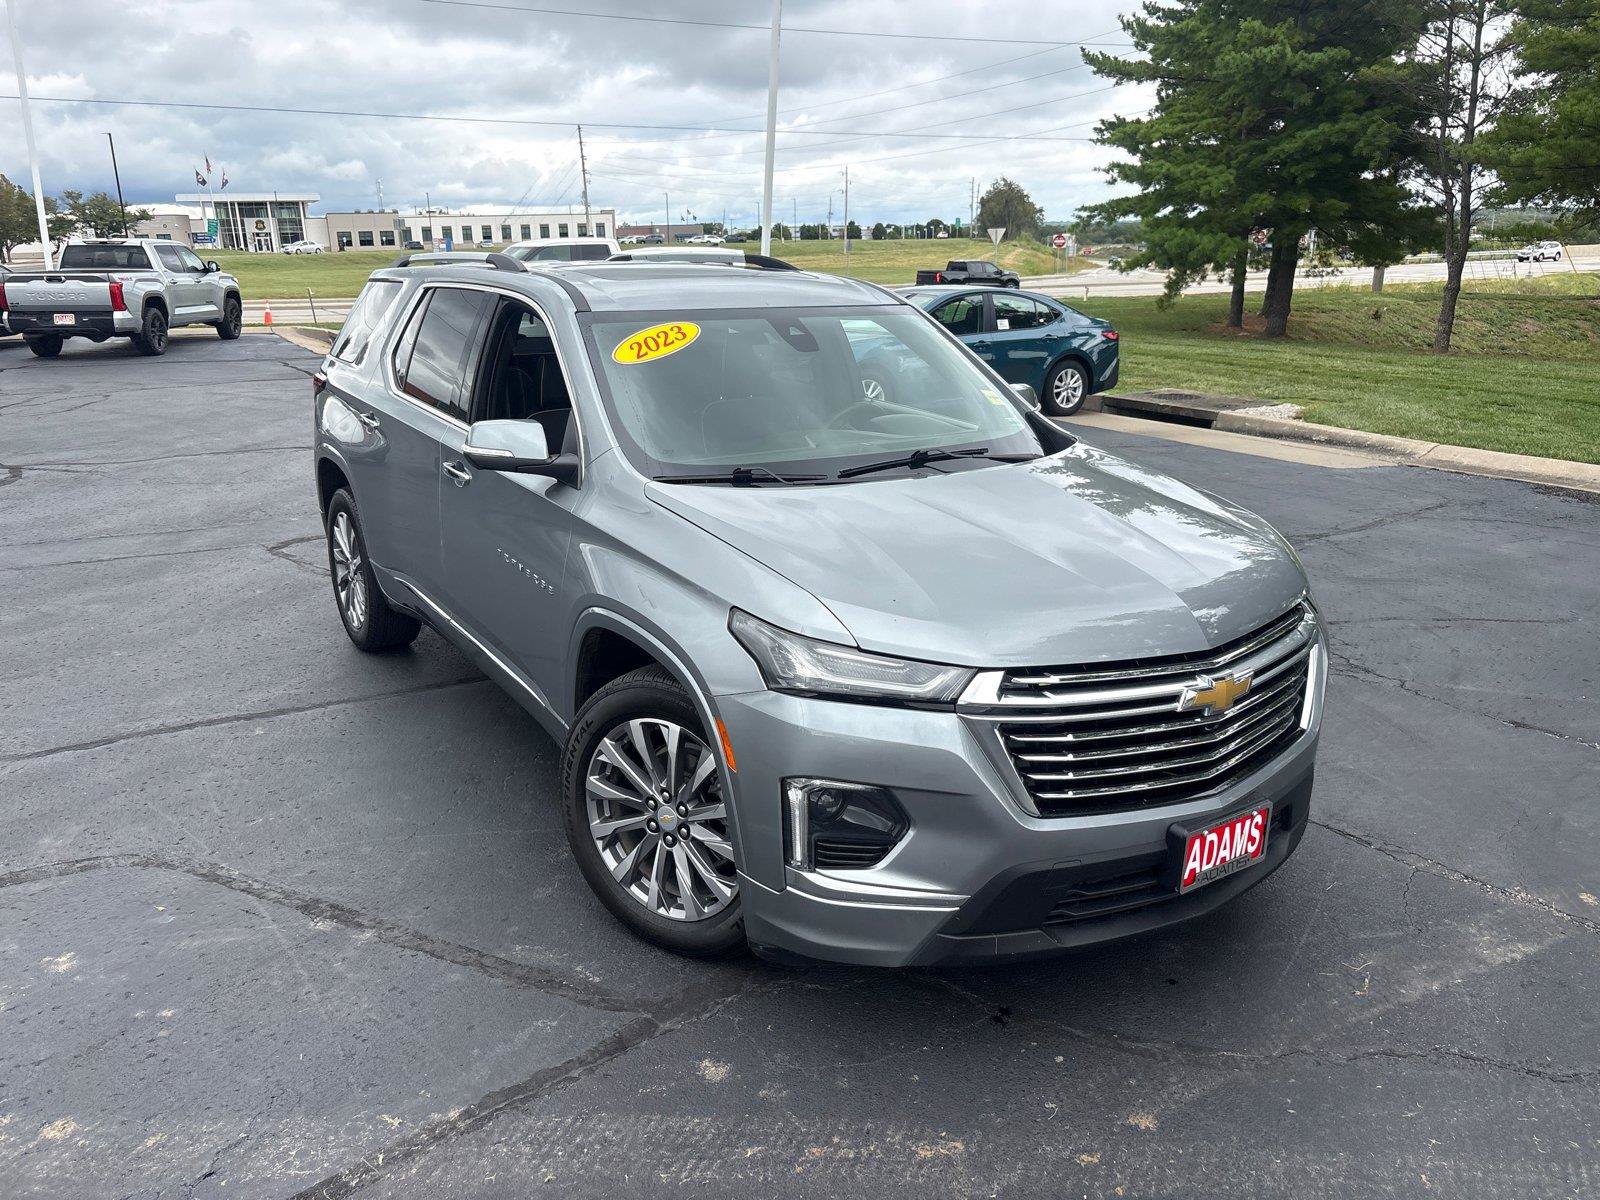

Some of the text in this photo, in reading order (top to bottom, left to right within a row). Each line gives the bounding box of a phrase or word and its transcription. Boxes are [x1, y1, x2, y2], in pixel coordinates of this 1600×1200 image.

[25, 292, 88, 301] TUNDRA
[629, 325, 687, 359] 2023
[1183, 814, 1262, 880] ADAMS
